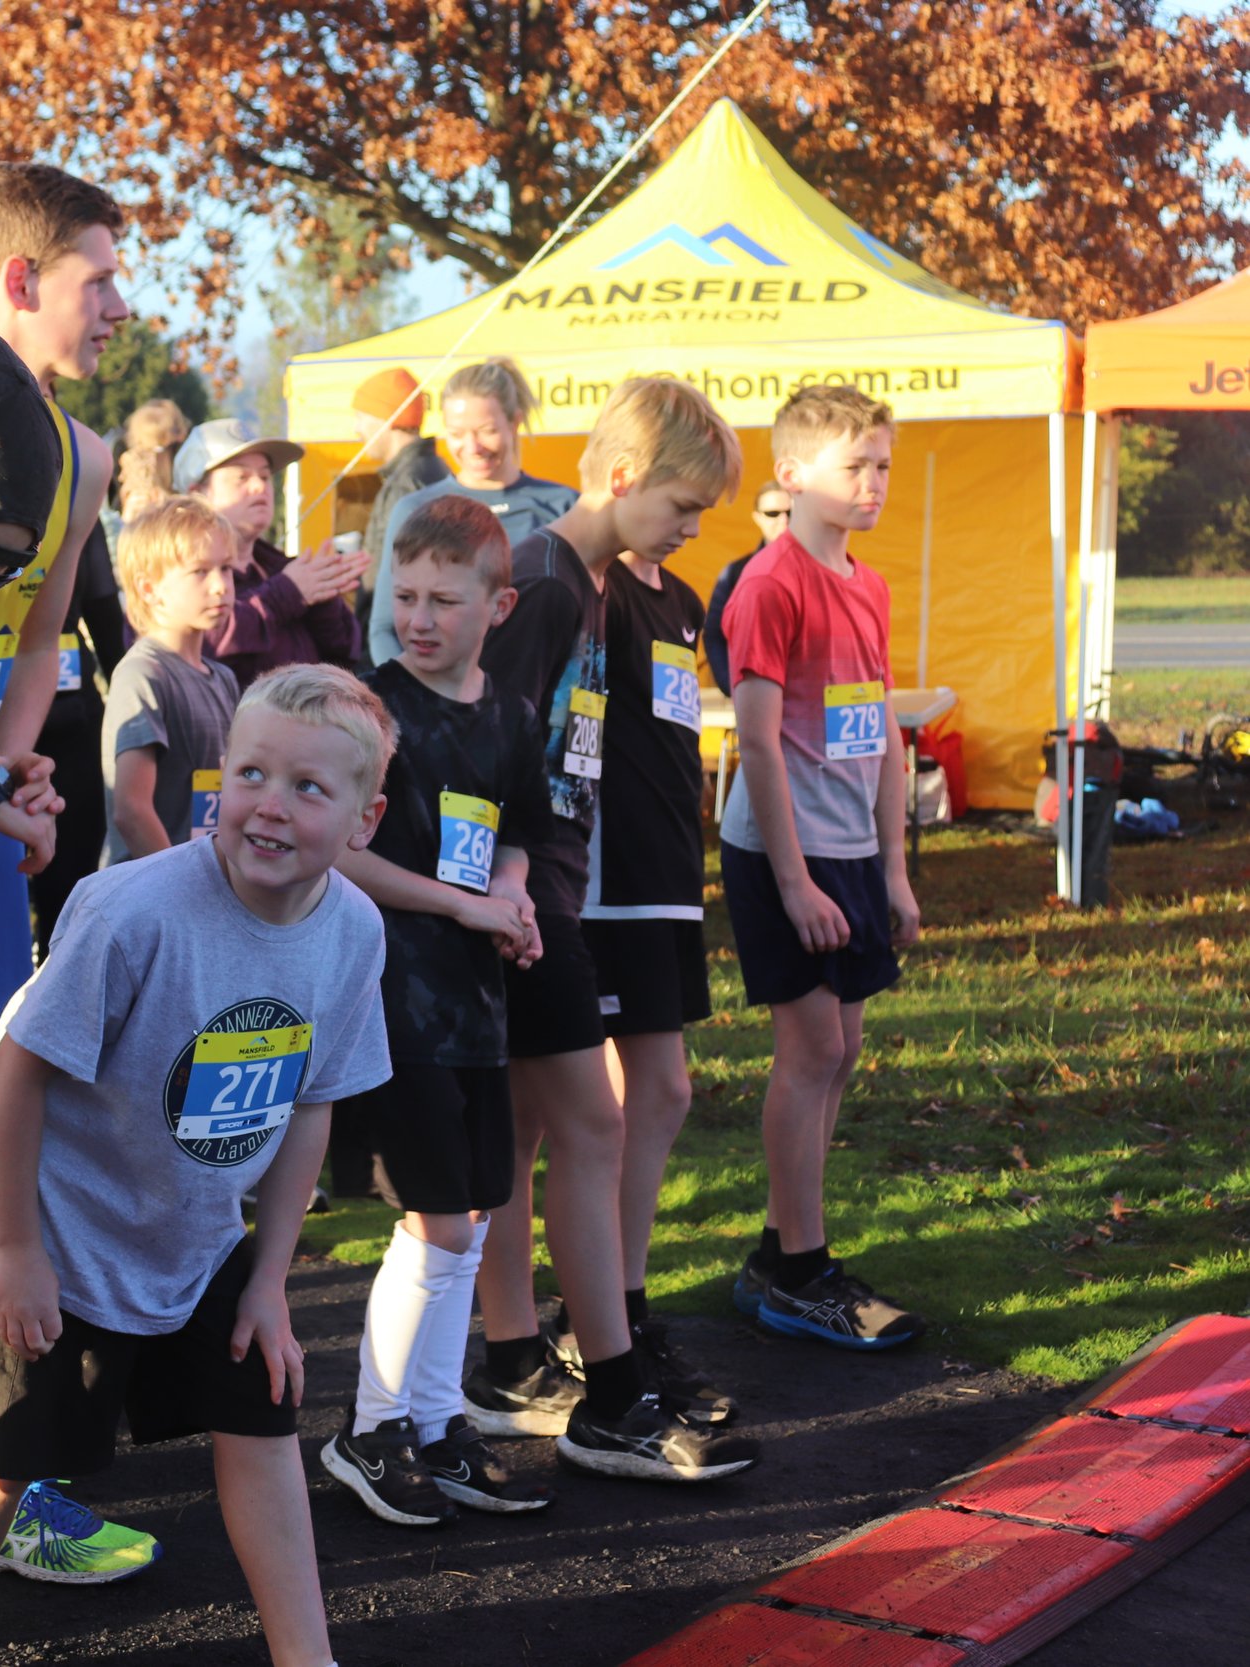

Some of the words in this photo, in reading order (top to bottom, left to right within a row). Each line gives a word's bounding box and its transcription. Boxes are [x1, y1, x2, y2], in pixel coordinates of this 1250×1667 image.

[502, 280, 868, 310] MANSFIELD
[569, 308, 781, 328] MARATHON
[571, 714, 598, 757] 208
[839, 704, 880, 740] 279
[453, 821, 494, 872] 268
[238, 1045, 275, 1055] MANSFIELD
[210, 1059, 284, 1113] 271
